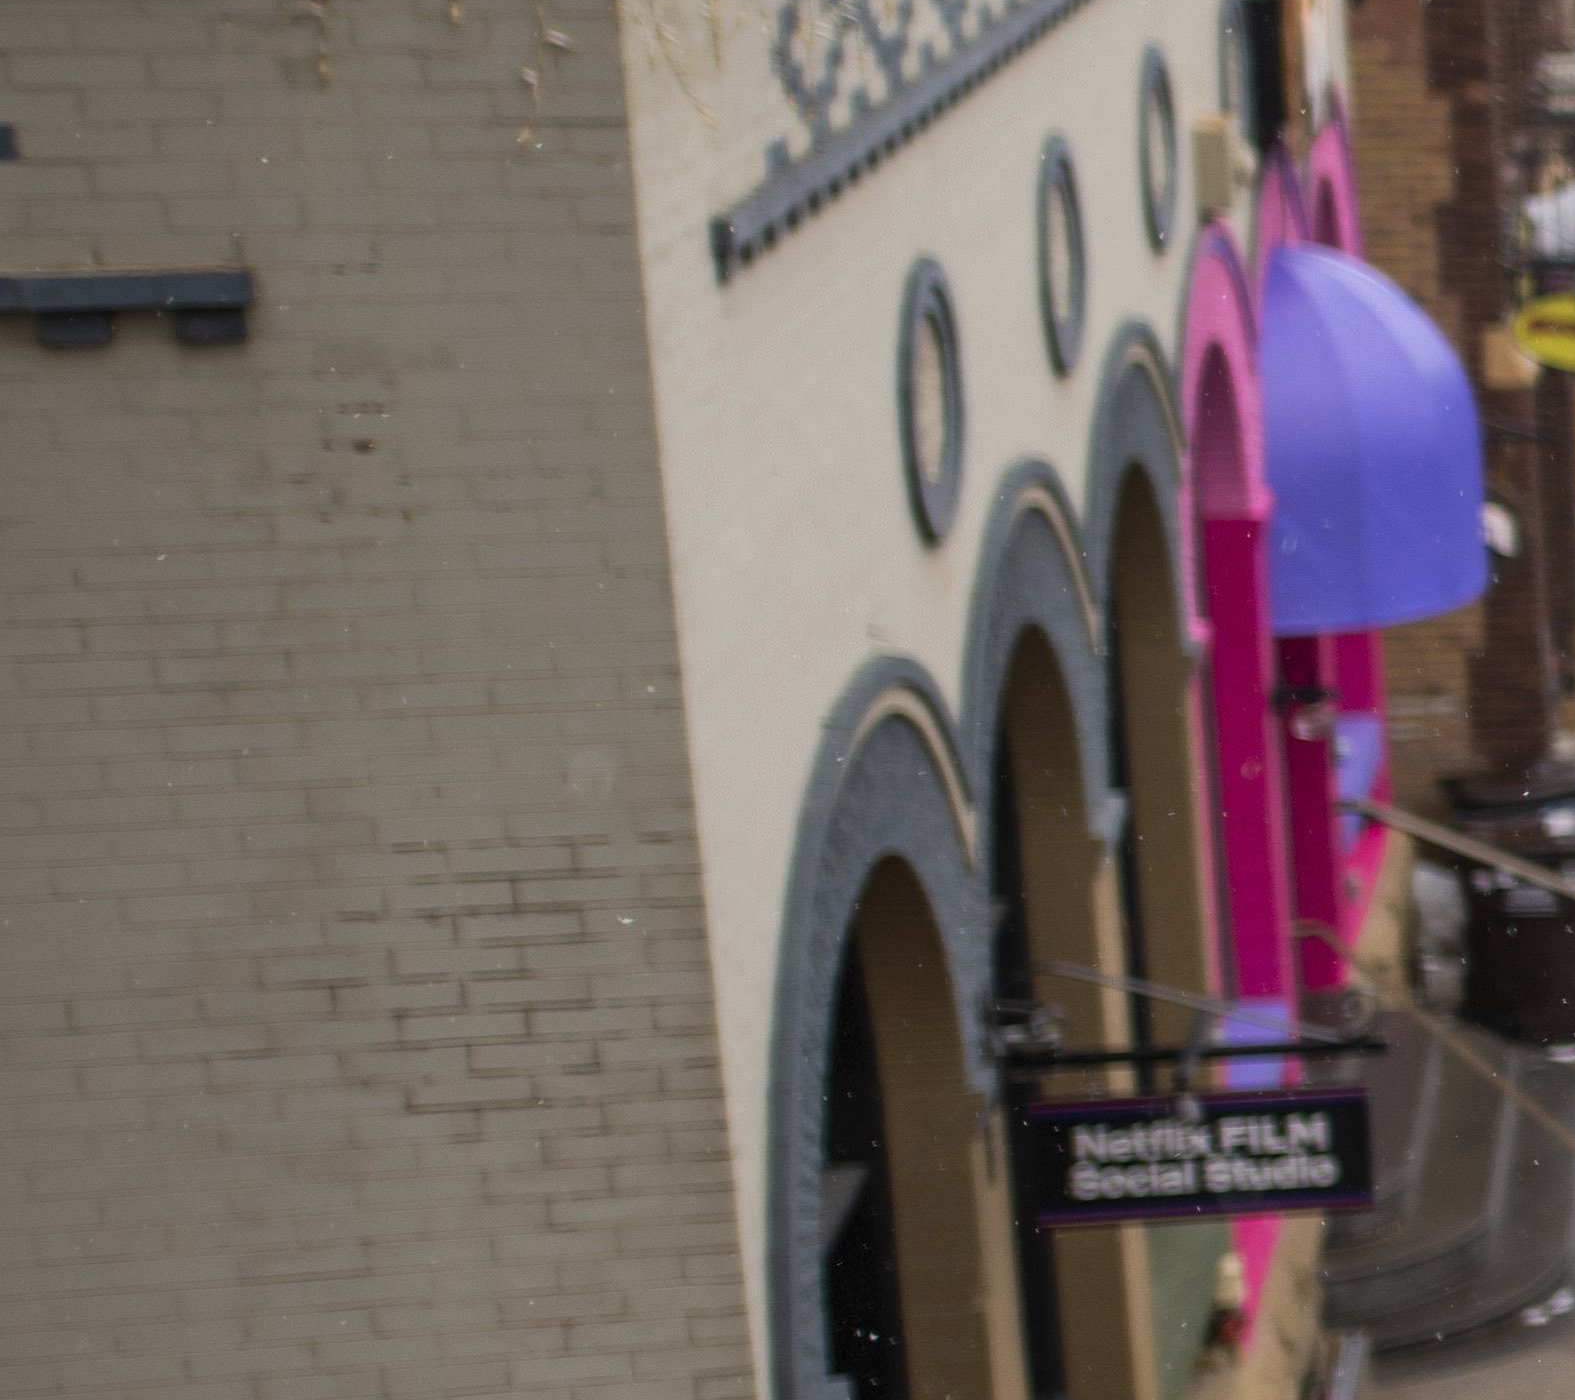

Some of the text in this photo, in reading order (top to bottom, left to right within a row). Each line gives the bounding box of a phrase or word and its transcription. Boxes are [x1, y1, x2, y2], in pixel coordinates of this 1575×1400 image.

[1070, 1112, 1331, 1162] Netflix FILM
[1068, 1152, 1340, 1200] Social Studio
